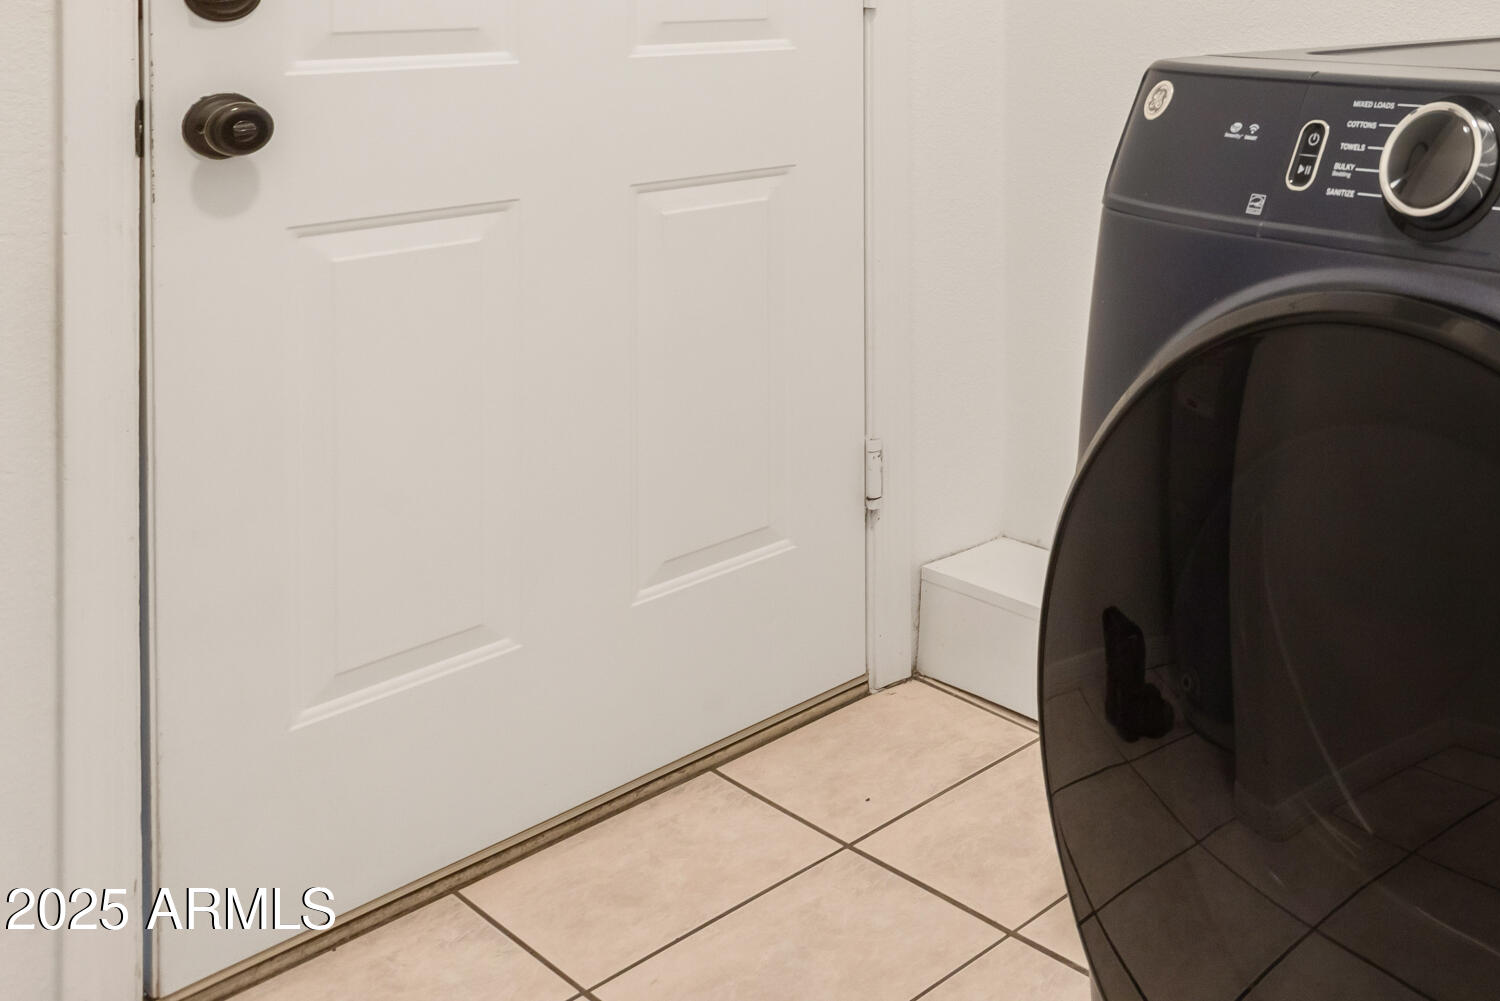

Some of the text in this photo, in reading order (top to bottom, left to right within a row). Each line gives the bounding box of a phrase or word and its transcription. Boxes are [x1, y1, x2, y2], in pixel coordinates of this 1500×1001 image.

[1374, 101, 1395, 110] LOADS
[1347, 120, 1377, 129] COTTONS
[1340, 142, 1366, 152] TOWELS
[1334, 162, 1356, 171] BULKY
[1326, 188, 1356, 198] SANITIZE
